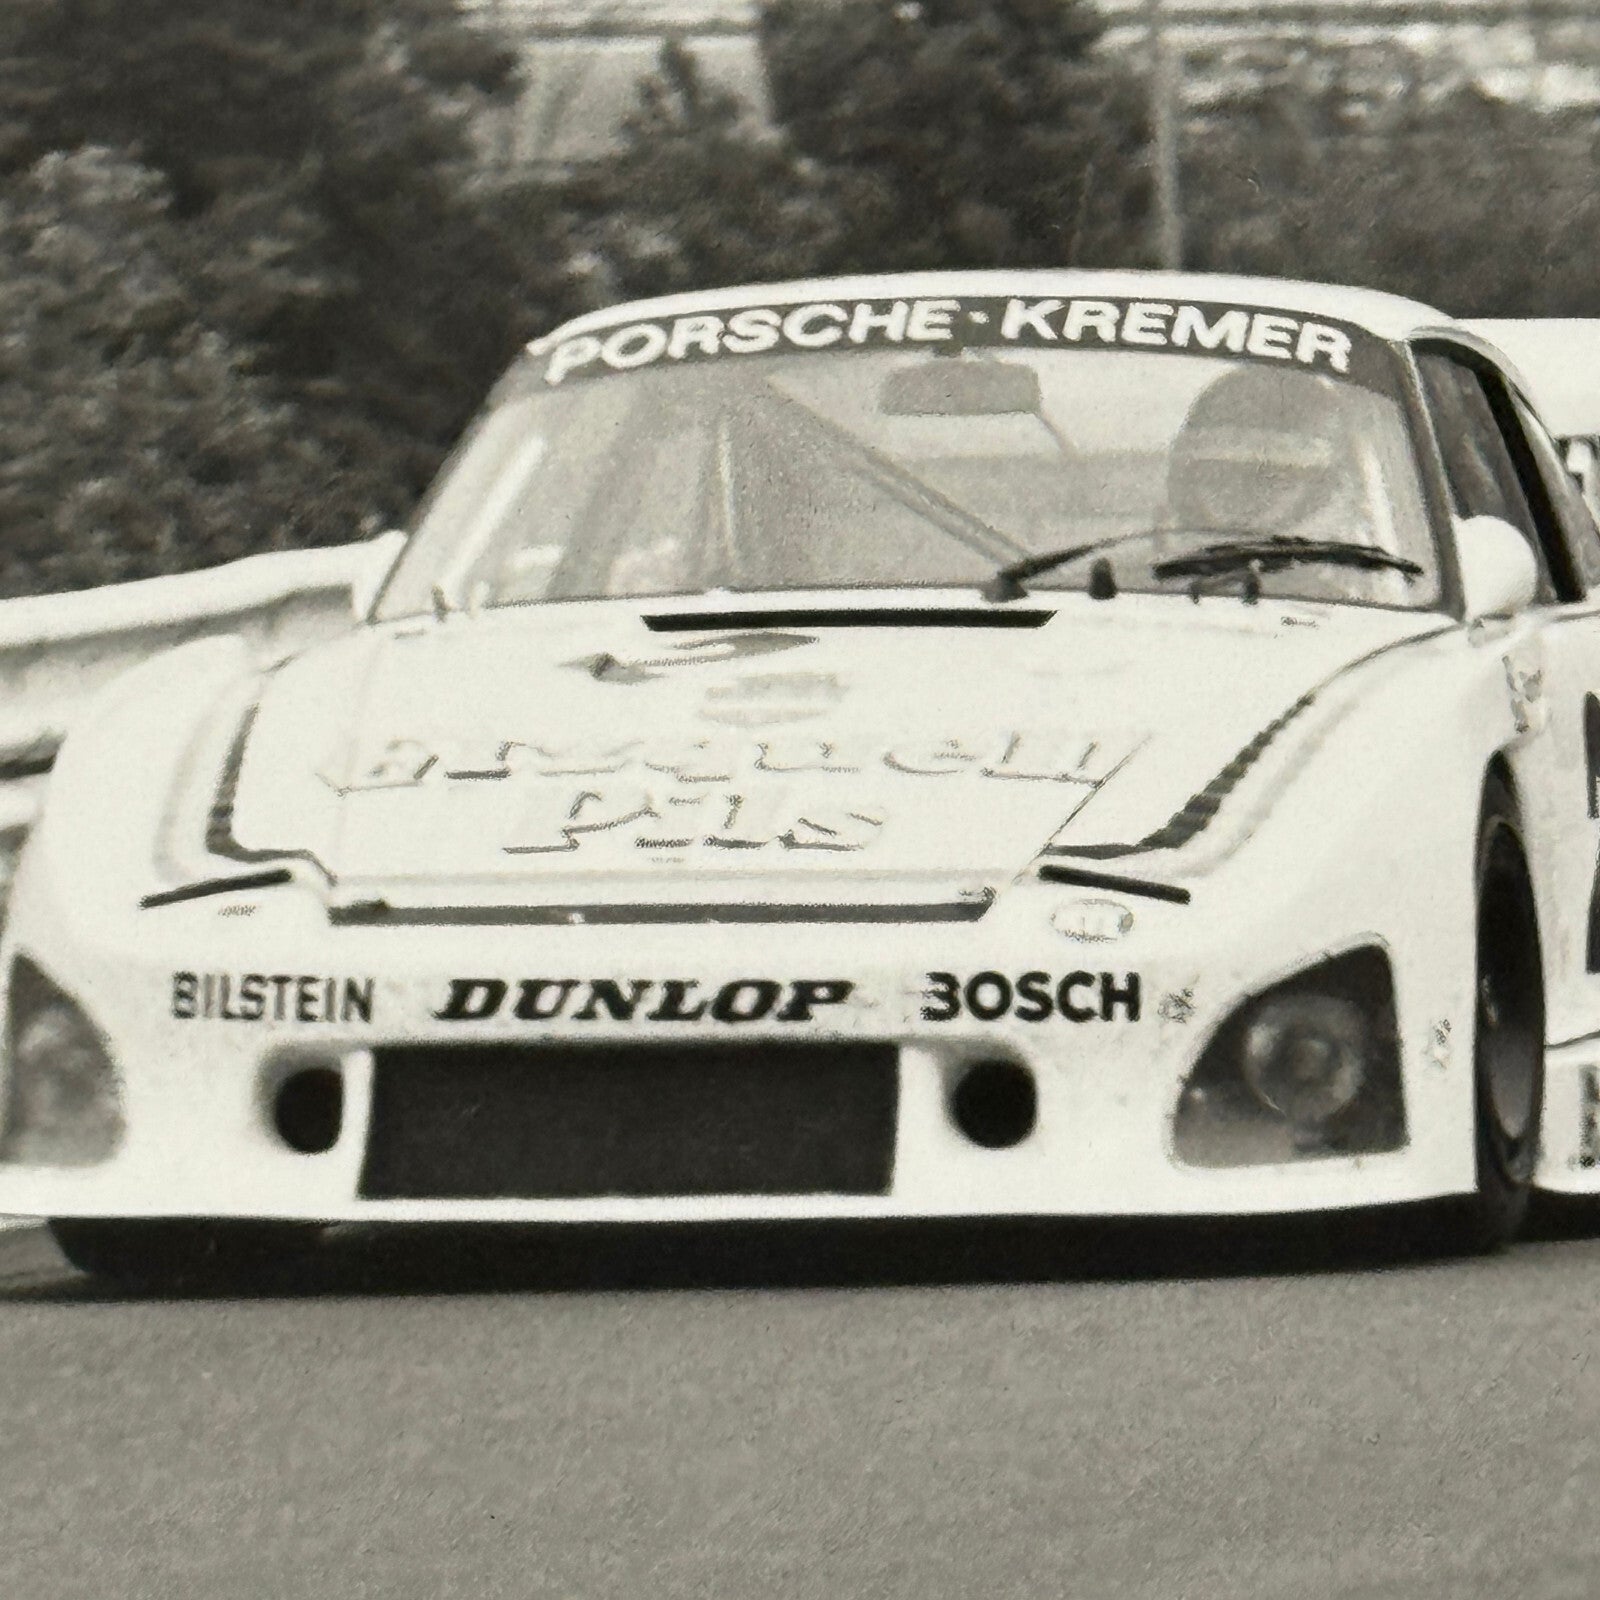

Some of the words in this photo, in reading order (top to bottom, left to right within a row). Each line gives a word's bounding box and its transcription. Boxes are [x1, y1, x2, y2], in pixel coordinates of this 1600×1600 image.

[545, 299, 957, 384] PORSCHE
[1000, 298, 1353, 372] KREMER
[172, 970, 376, 1023] BILSTEIN
[434, 978, 853, 1023] DUNLOP
